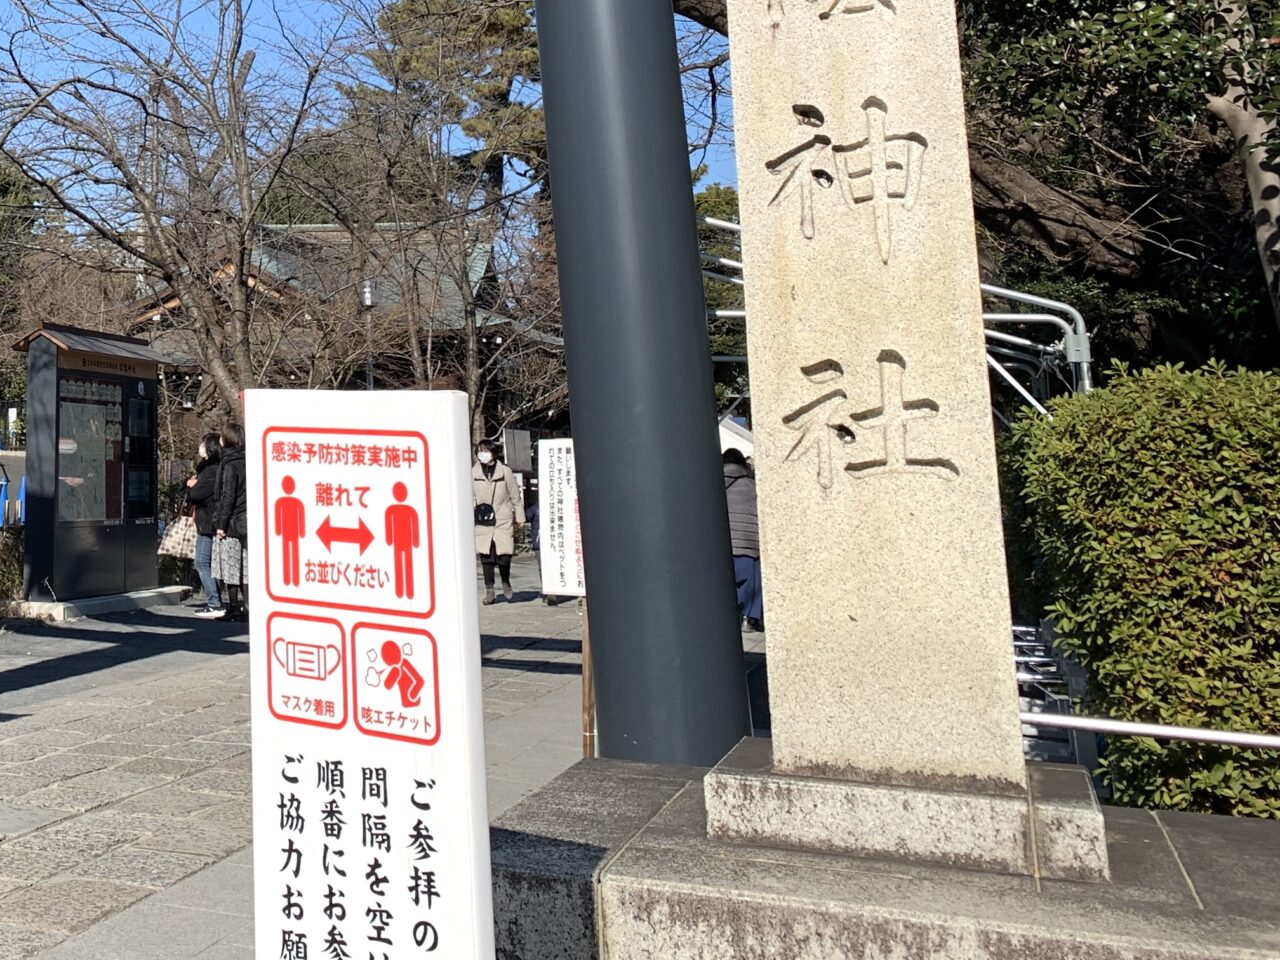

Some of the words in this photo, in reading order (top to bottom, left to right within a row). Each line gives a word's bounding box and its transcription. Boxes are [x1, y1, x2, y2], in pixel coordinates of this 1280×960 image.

[270, 441, 419, 470] 感染予防対策実施中
[314, 482, 371, 509] 離れて
[304, 559, 391, 591] お並びください
[280, 693, 336, 719] マスク着用
[360, 704, 433, 734] 咳エチケット
